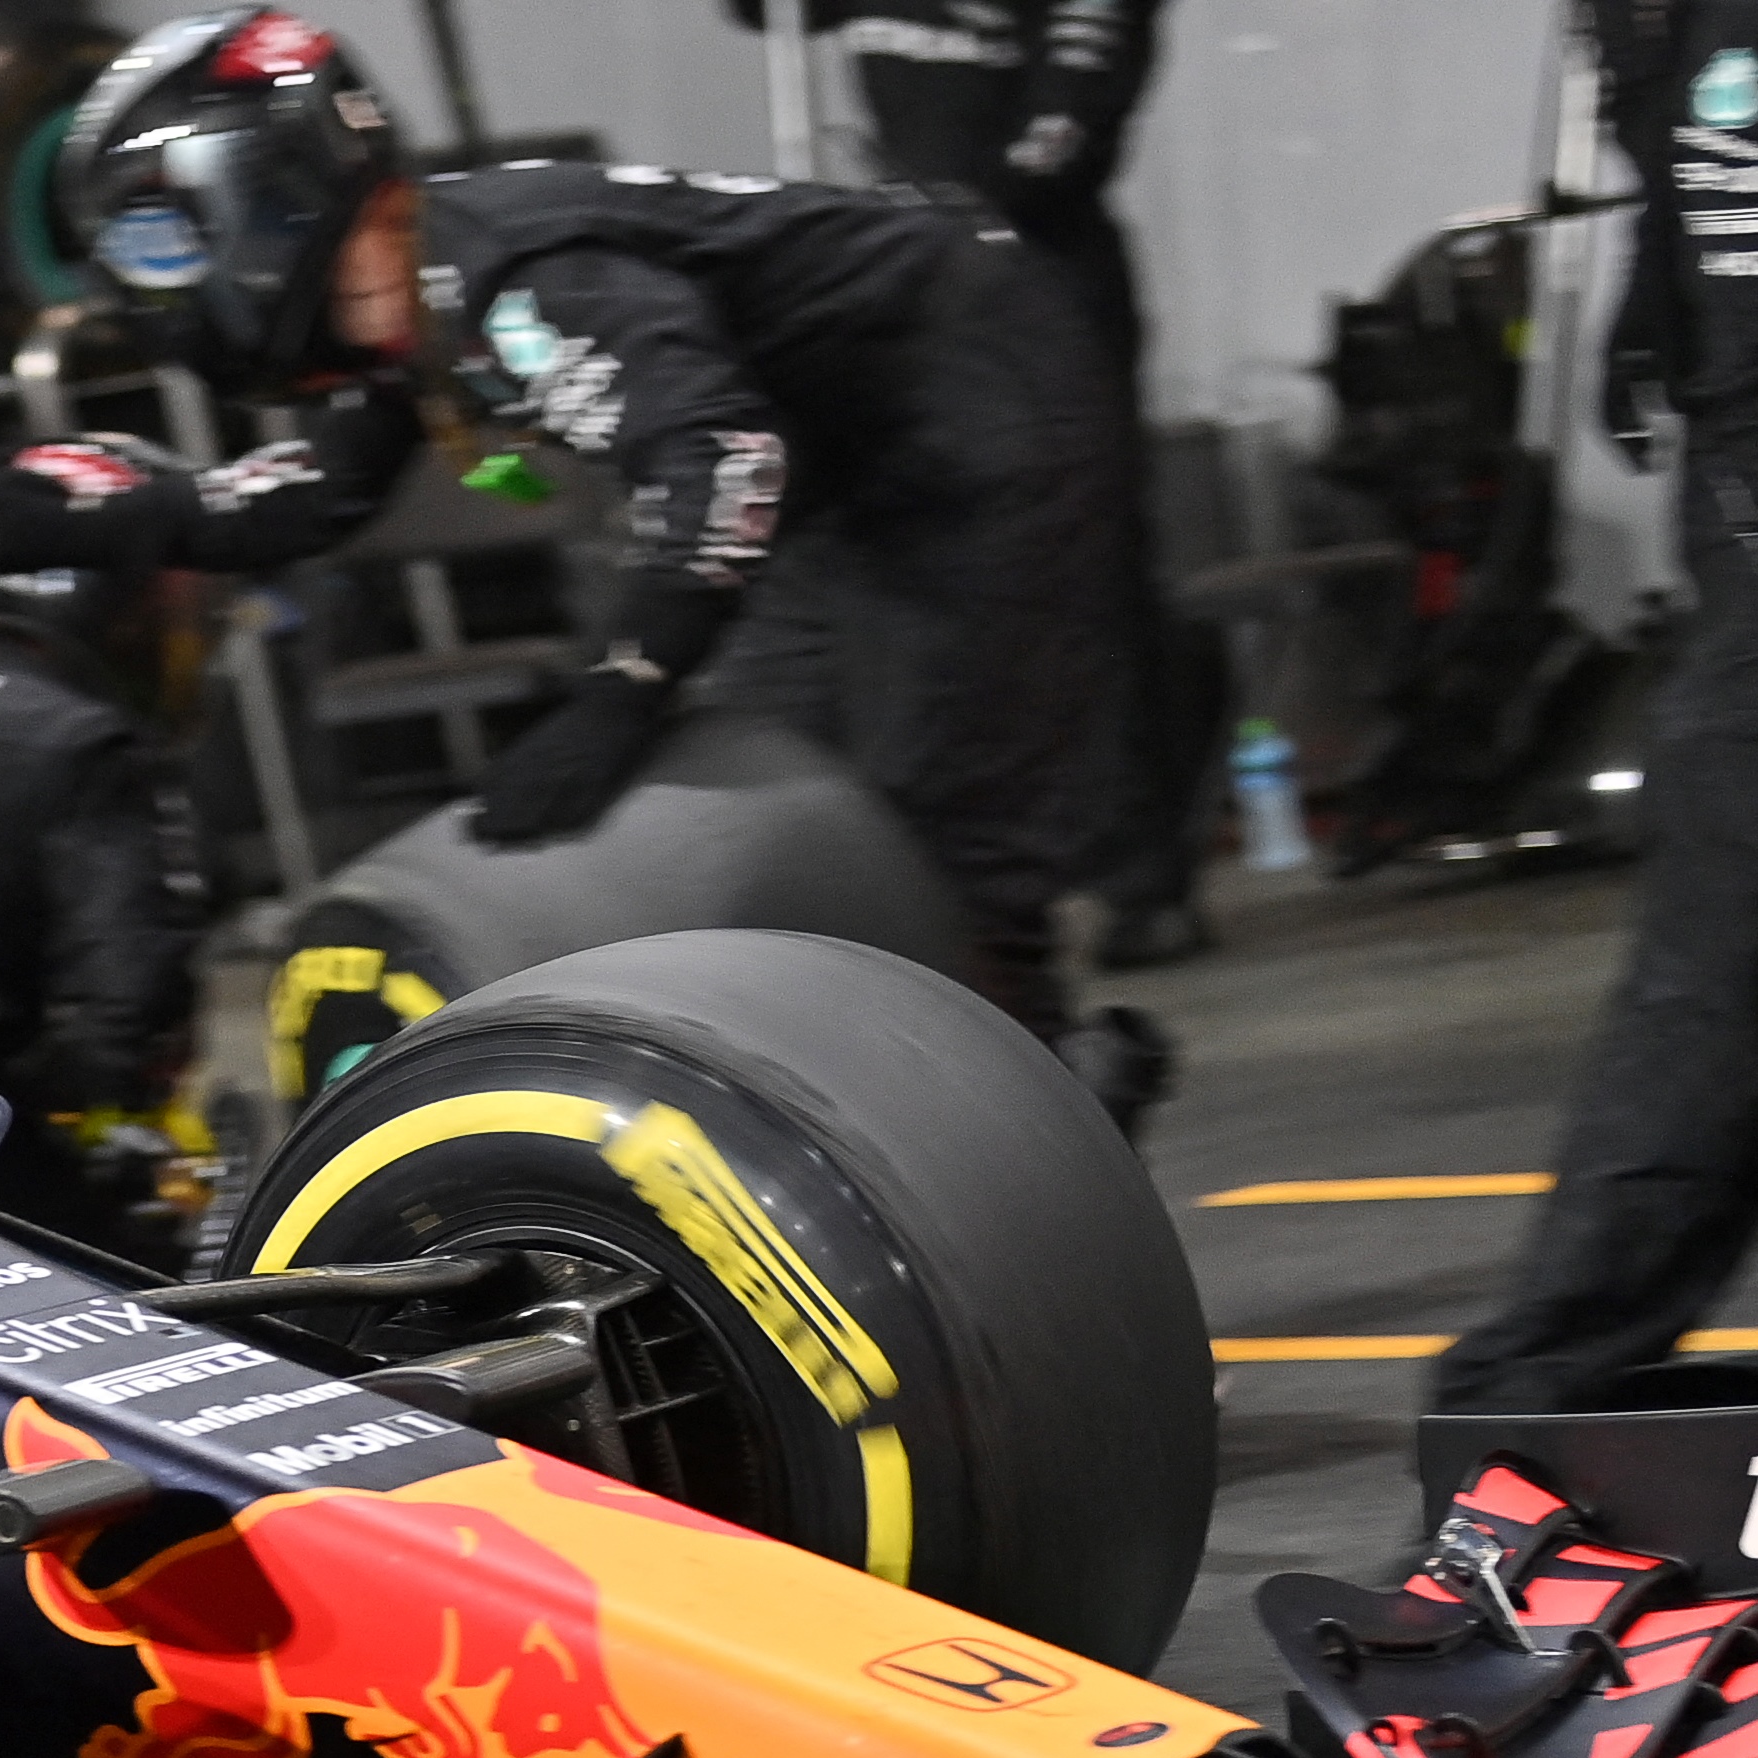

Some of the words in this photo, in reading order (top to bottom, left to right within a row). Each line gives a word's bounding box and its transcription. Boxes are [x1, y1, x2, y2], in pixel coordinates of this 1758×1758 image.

[61, 1342, 280, 1405] PIRELLI
[158, 1380, 364, 1438] infinitum
[246, 1422, 416, 1476] Mobil
